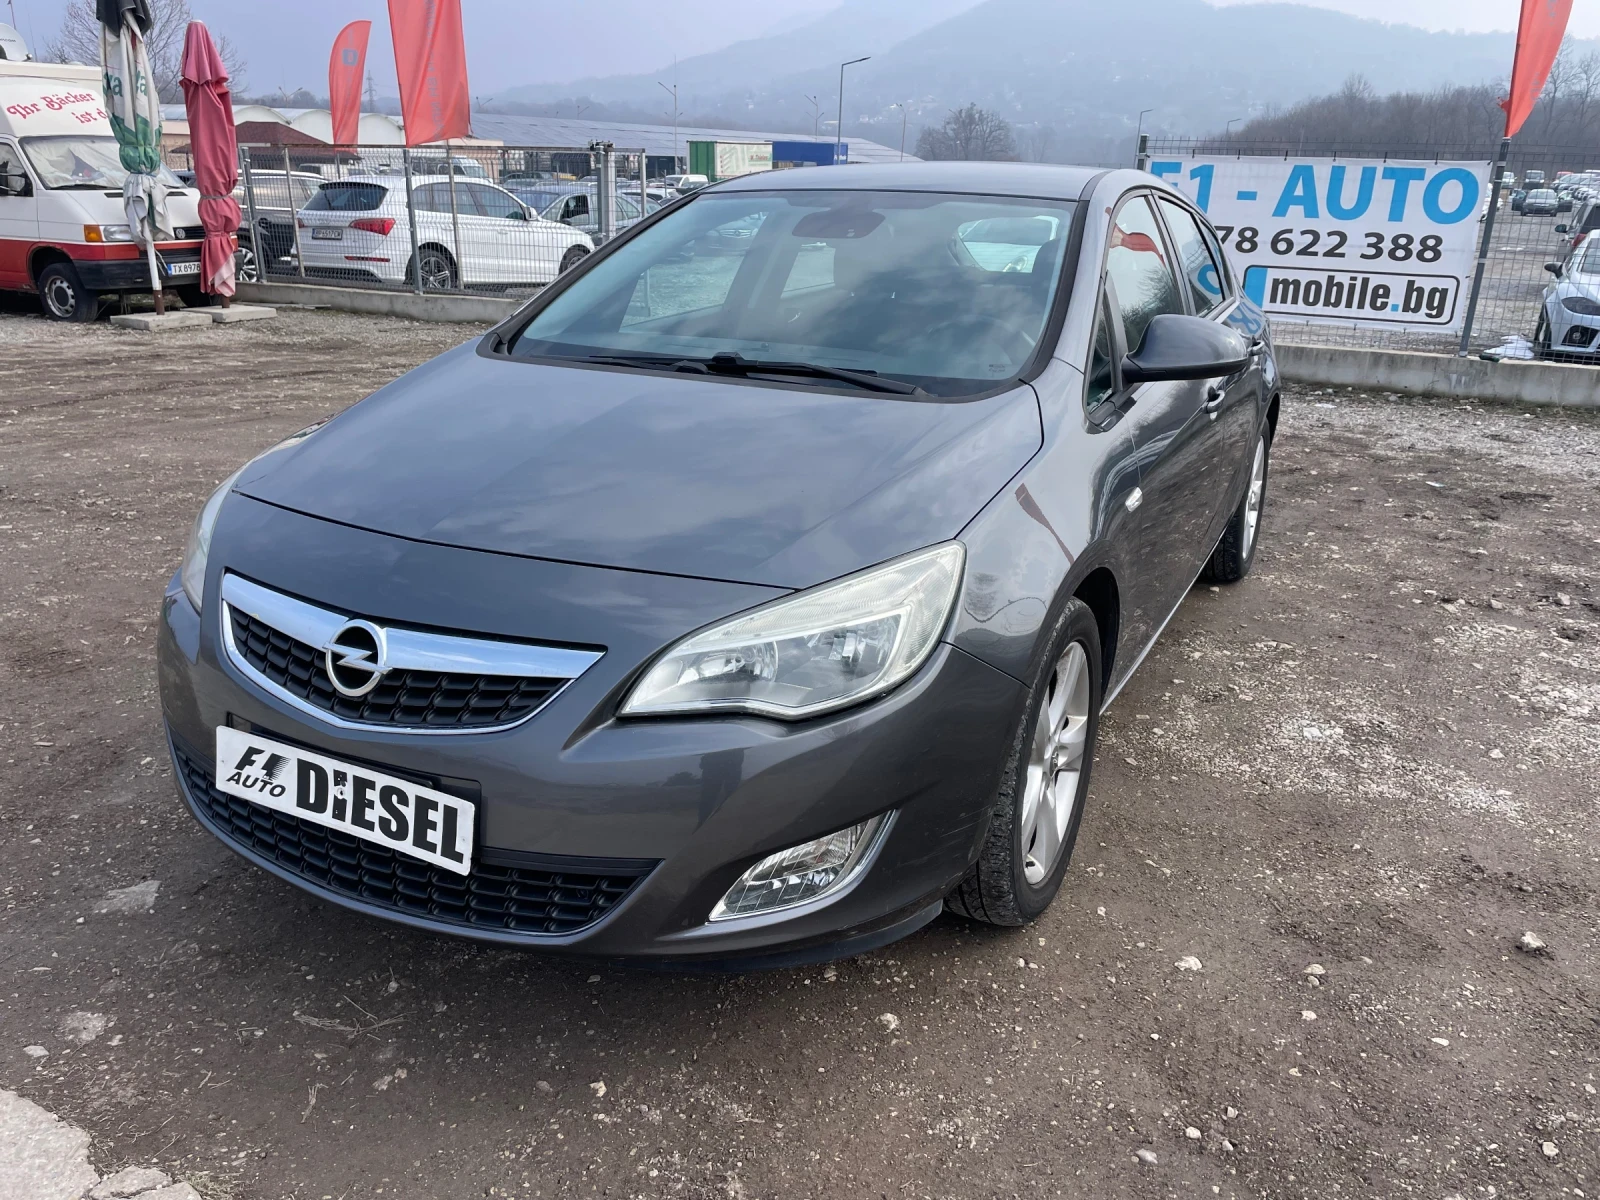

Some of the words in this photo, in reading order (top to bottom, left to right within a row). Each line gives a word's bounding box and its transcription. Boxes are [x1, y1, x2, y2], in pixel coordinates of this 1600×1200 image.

[41, 92, 95, 111] Bäcker
[71, 111, 97, 124] ist
[1272, 164, 1480, 225] AUTO
[1270, 228, 1348, 259] 622
[1360, 232, 1443, 263] 388
[1269, 275, 1449, 318] mobile.bg
[225, 771, 287, 798] AUTO
